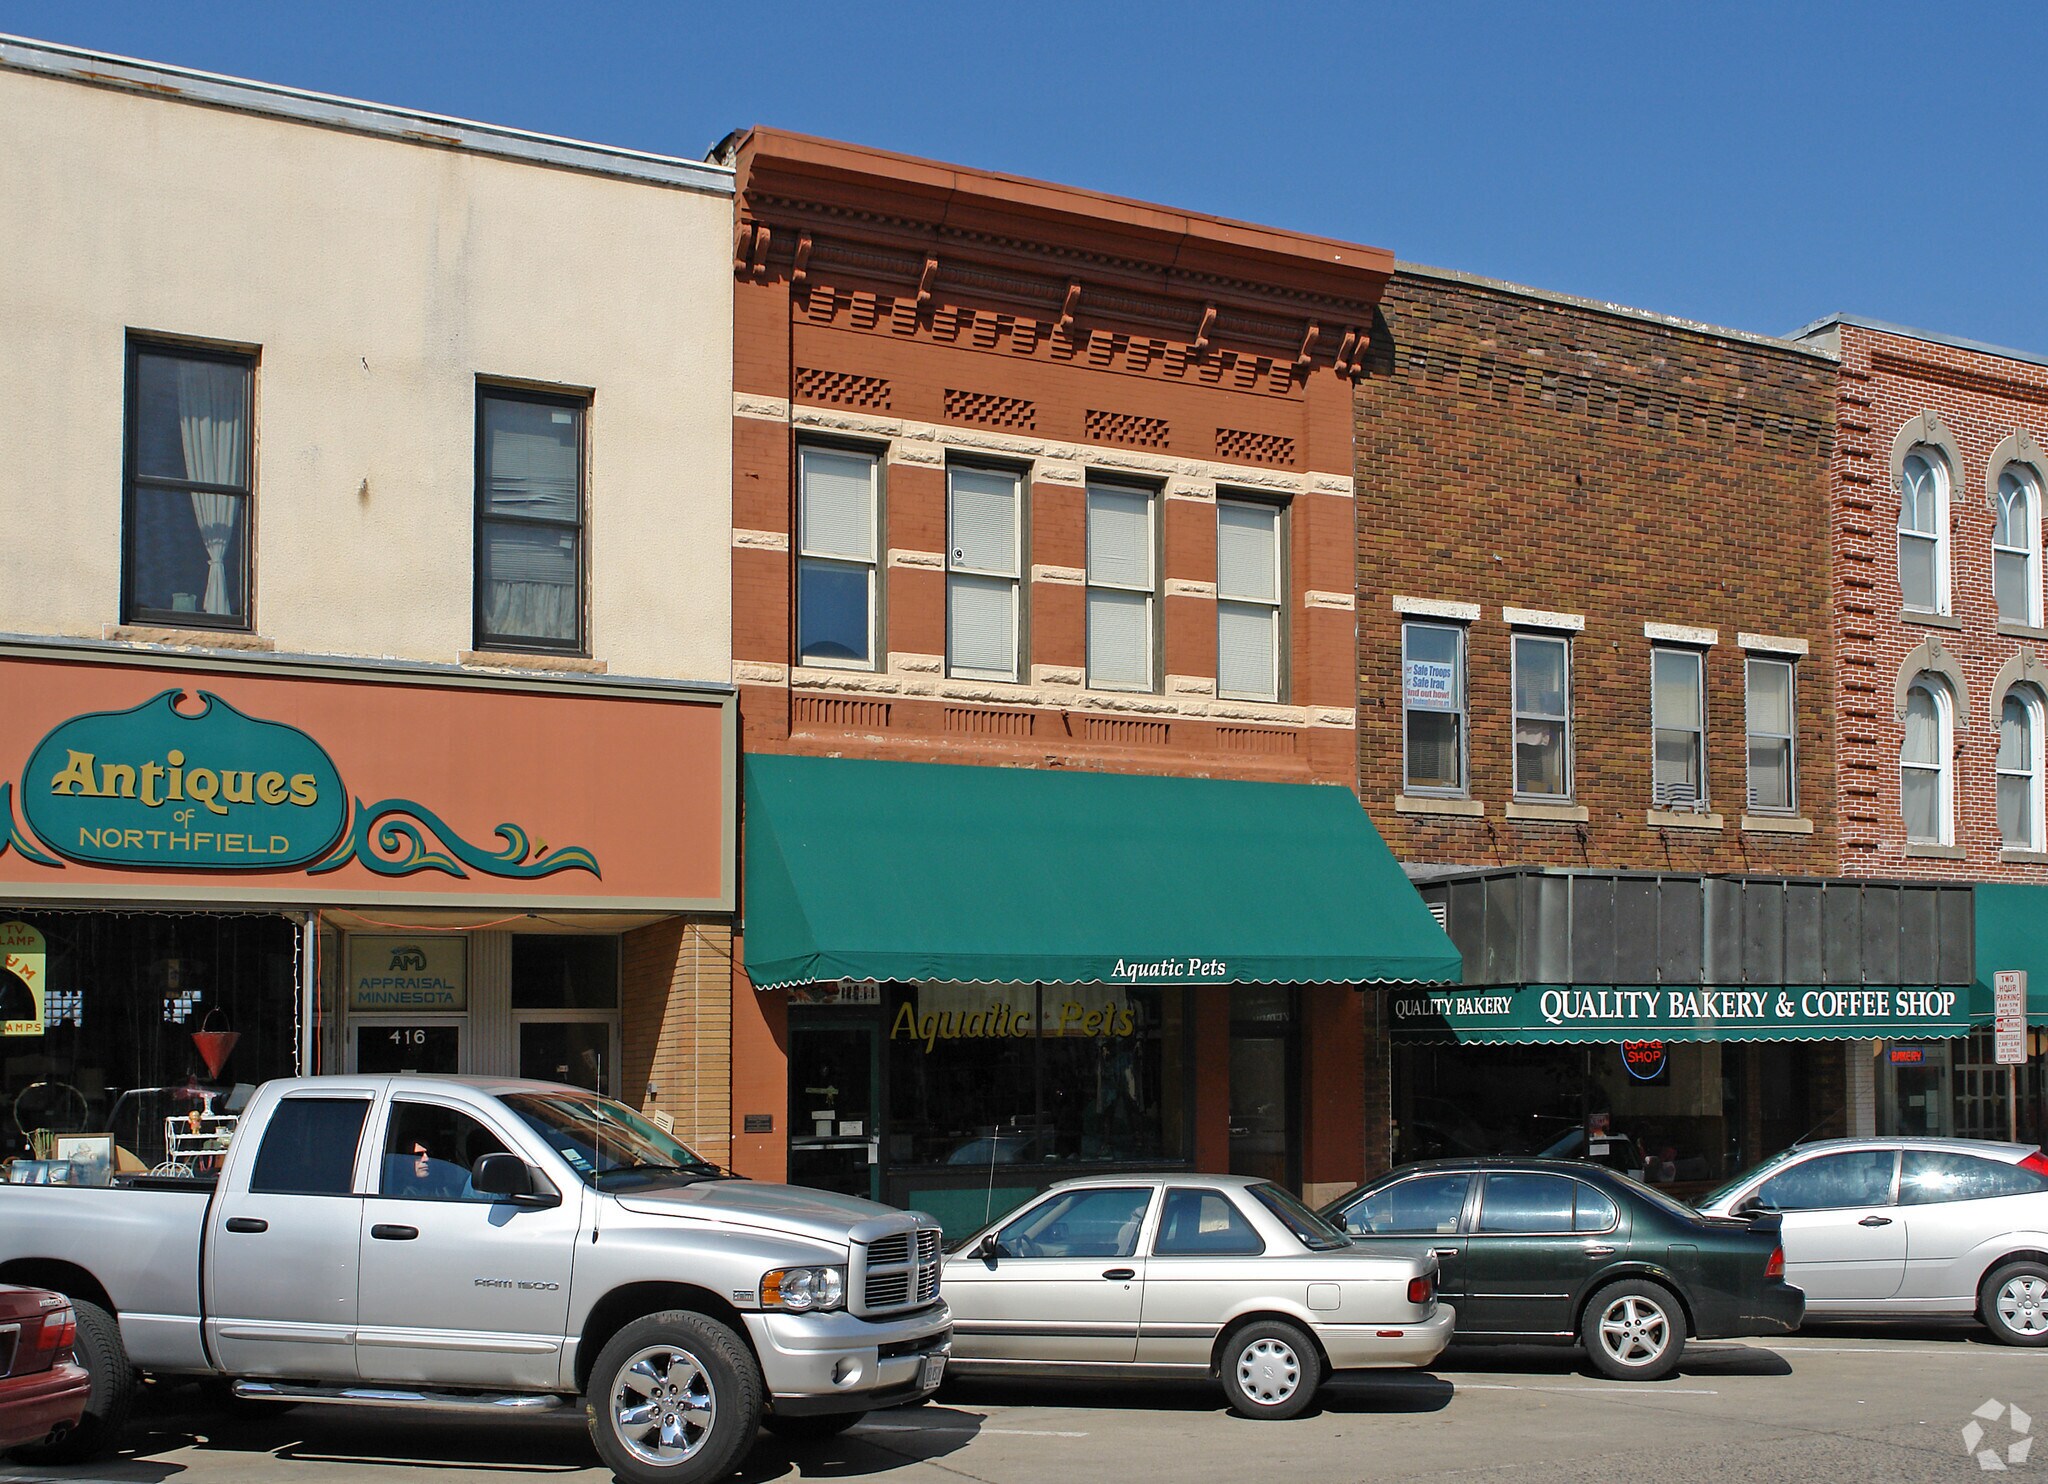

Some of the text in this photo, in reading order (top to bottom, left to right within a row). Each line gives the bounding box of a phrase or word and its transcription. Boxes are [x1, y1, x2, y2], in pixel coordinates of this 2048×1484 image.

[1413, 664, 1451, 678] Safe Troops
[1413, 676, 1445, 690] Safe Iraq
[1420, 689, 1432, 698] out
[50, 748, 319, 815] Antiques
[173, 808, 196, 829] of
[79, 827, 290, 854] NORTHFIELD
[5, 924, 25, 934] TV
[0, 936, 36, 946] LAMP
[388, 950, 427, 971] AM
[1111, 958, 1226, 983] Aquatic Pets
[358, 977, 455, 989] APPRAISAL
[2001, 975, 2014, 983] TWO
[1999, 984, 2017, 993] HOUR
[358, 992, 455, 1003] MINNESOTA
[1996, 993, 2020, 1002] PARKING
[1395, 996, 1513, 1019] QUALITY BAKERY
[1539, 990, 1955, 1025] QUALITY BAKERY & COFFEE SHOP
[889, 1001, 1135, 1054] Aquatic Pets
[389, 1029, 426, 1045] 416
[1627, 1050, 1661, 1063] SHOP
[1891, 1050, 1922, 1062] BAKERY
[474, 1278, 560, 1291] RAM 1500
